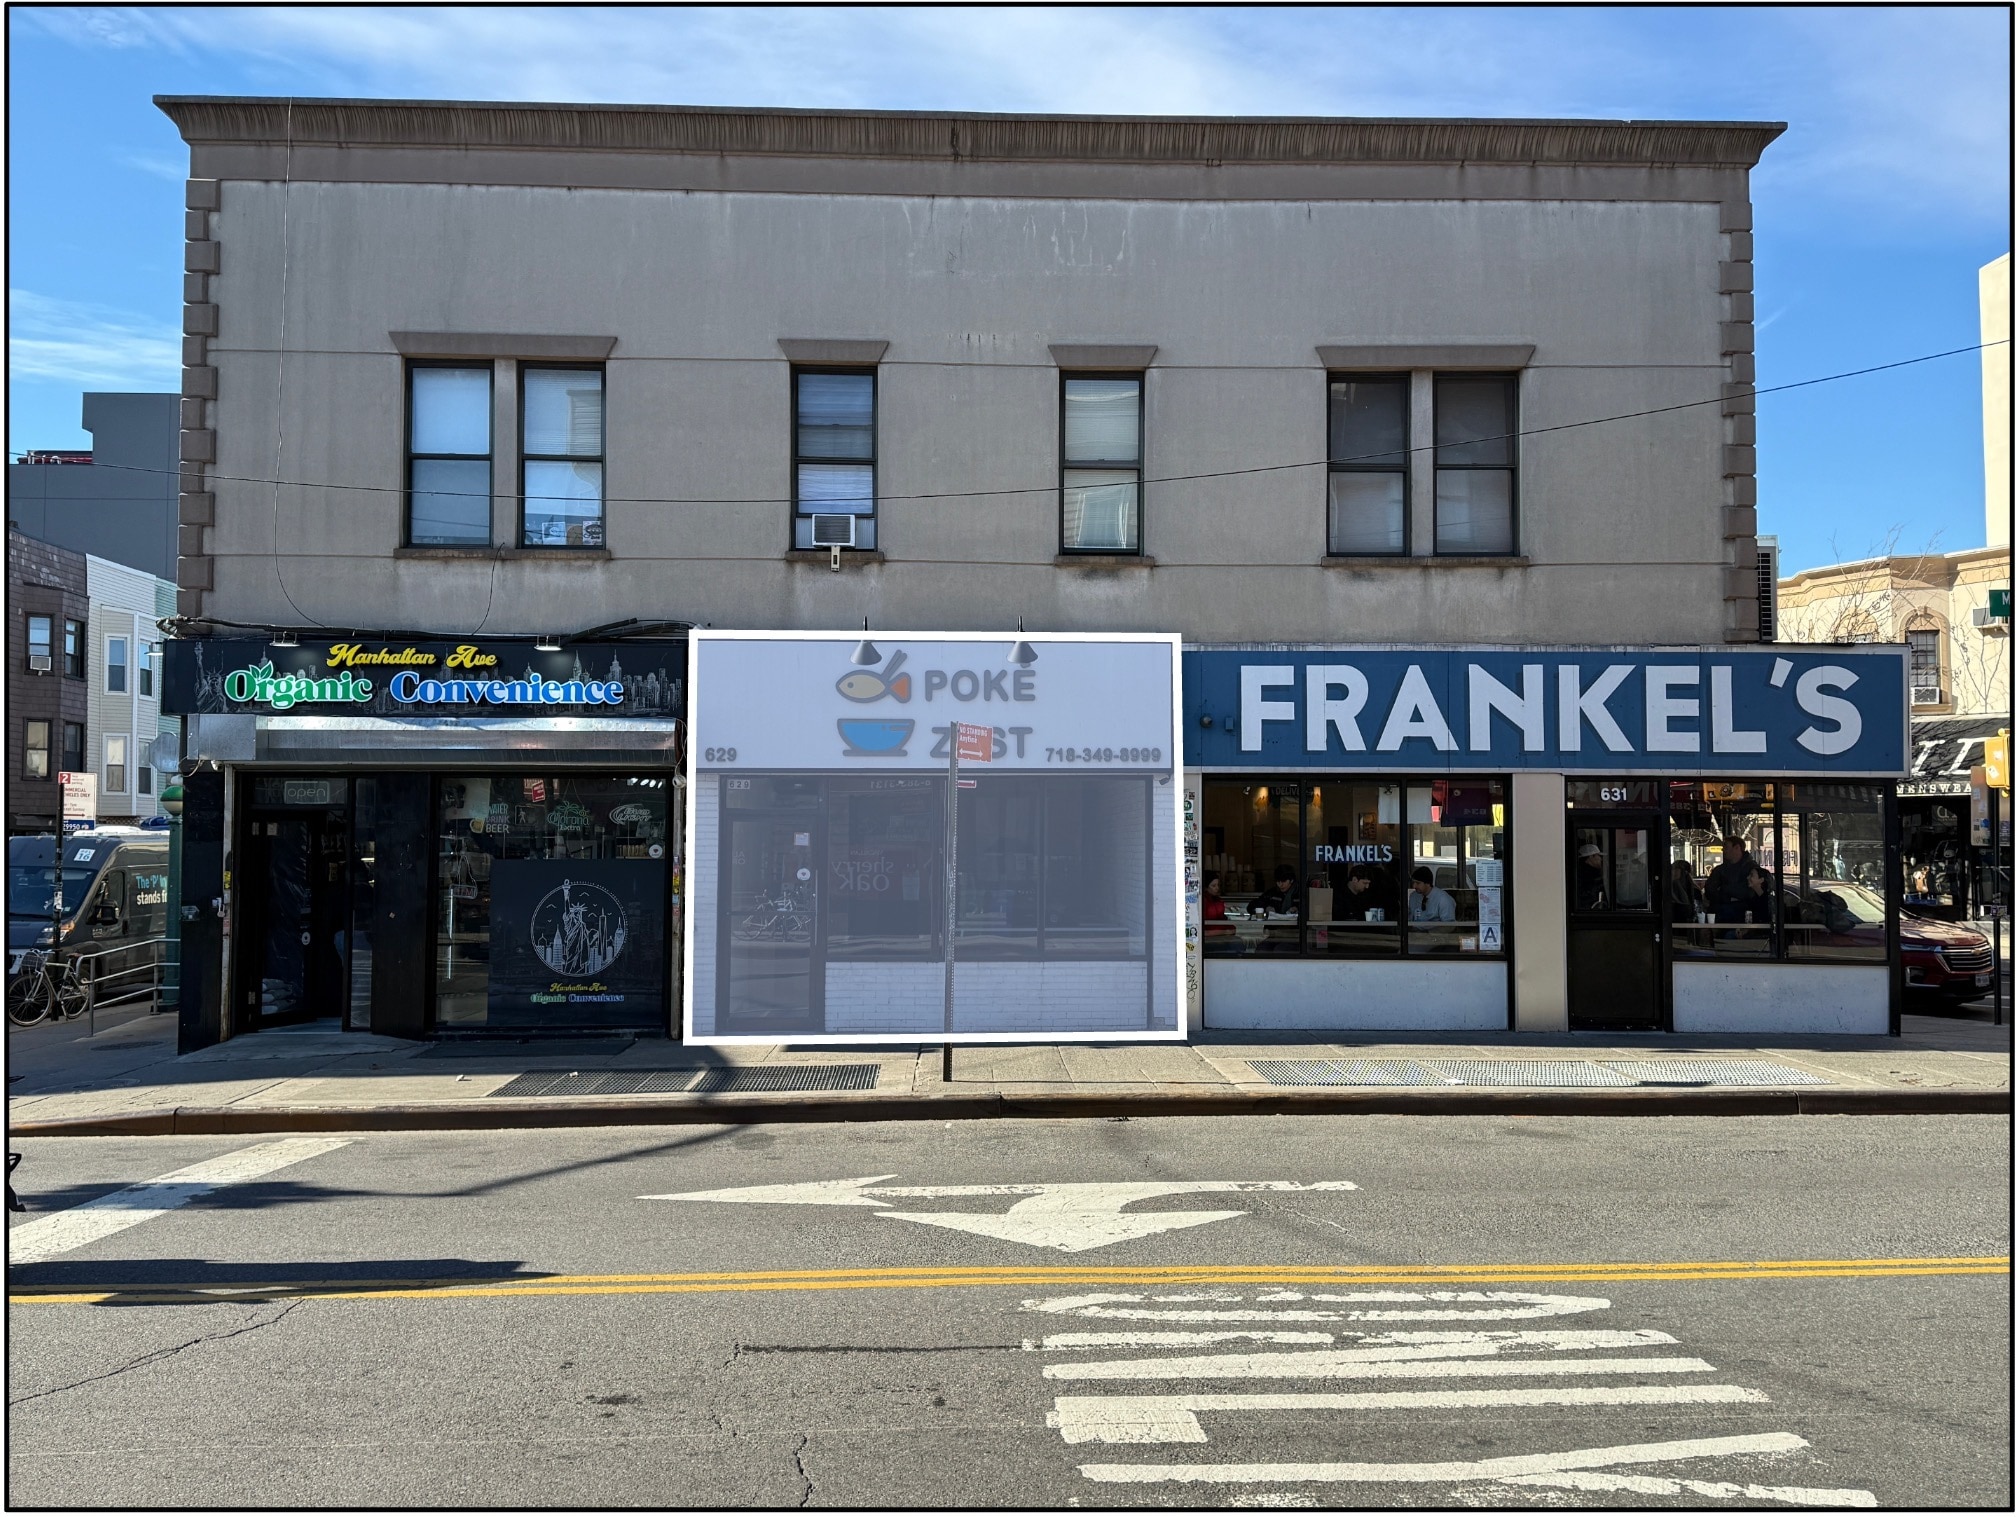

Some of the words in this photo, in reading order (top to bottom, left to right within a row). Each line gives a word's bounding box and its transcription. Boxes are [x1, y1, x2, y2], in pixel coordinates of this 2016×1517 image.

[326, 643, 436, 667] Manhattan
[444, 644, 498, 669] Ave
[224, 667, 373, 710] Organic
[389, 669, 625, 706] Convenience
[1240, 656, 1863, 756] FRANKEL'S
[959, 726, 967, 734] NO
[966, 727, 988, 737] STANDING
[929, 726, 1034, 759] ZST
[959, 735, 978, 744] Anytime
[705, 747, 737, 763] 629
[1045, 747, 1162, 763] 718-349-8999
[61, 774, 69, 783] 2
[729, 780, 750, 789] 629
[287, 788, 326, 800] open
[1600, 787, 1628, 802] 631
[1896, 783, 1972, 794] MENSWEA
[485, 823, 510, 834] BEER
[1315, 844, 1393, 862] FRANKEL'S
[135, 875, 150, 889] The
[136, 890, 161, 906] stands
[1483, 926, 1498, 943] A
